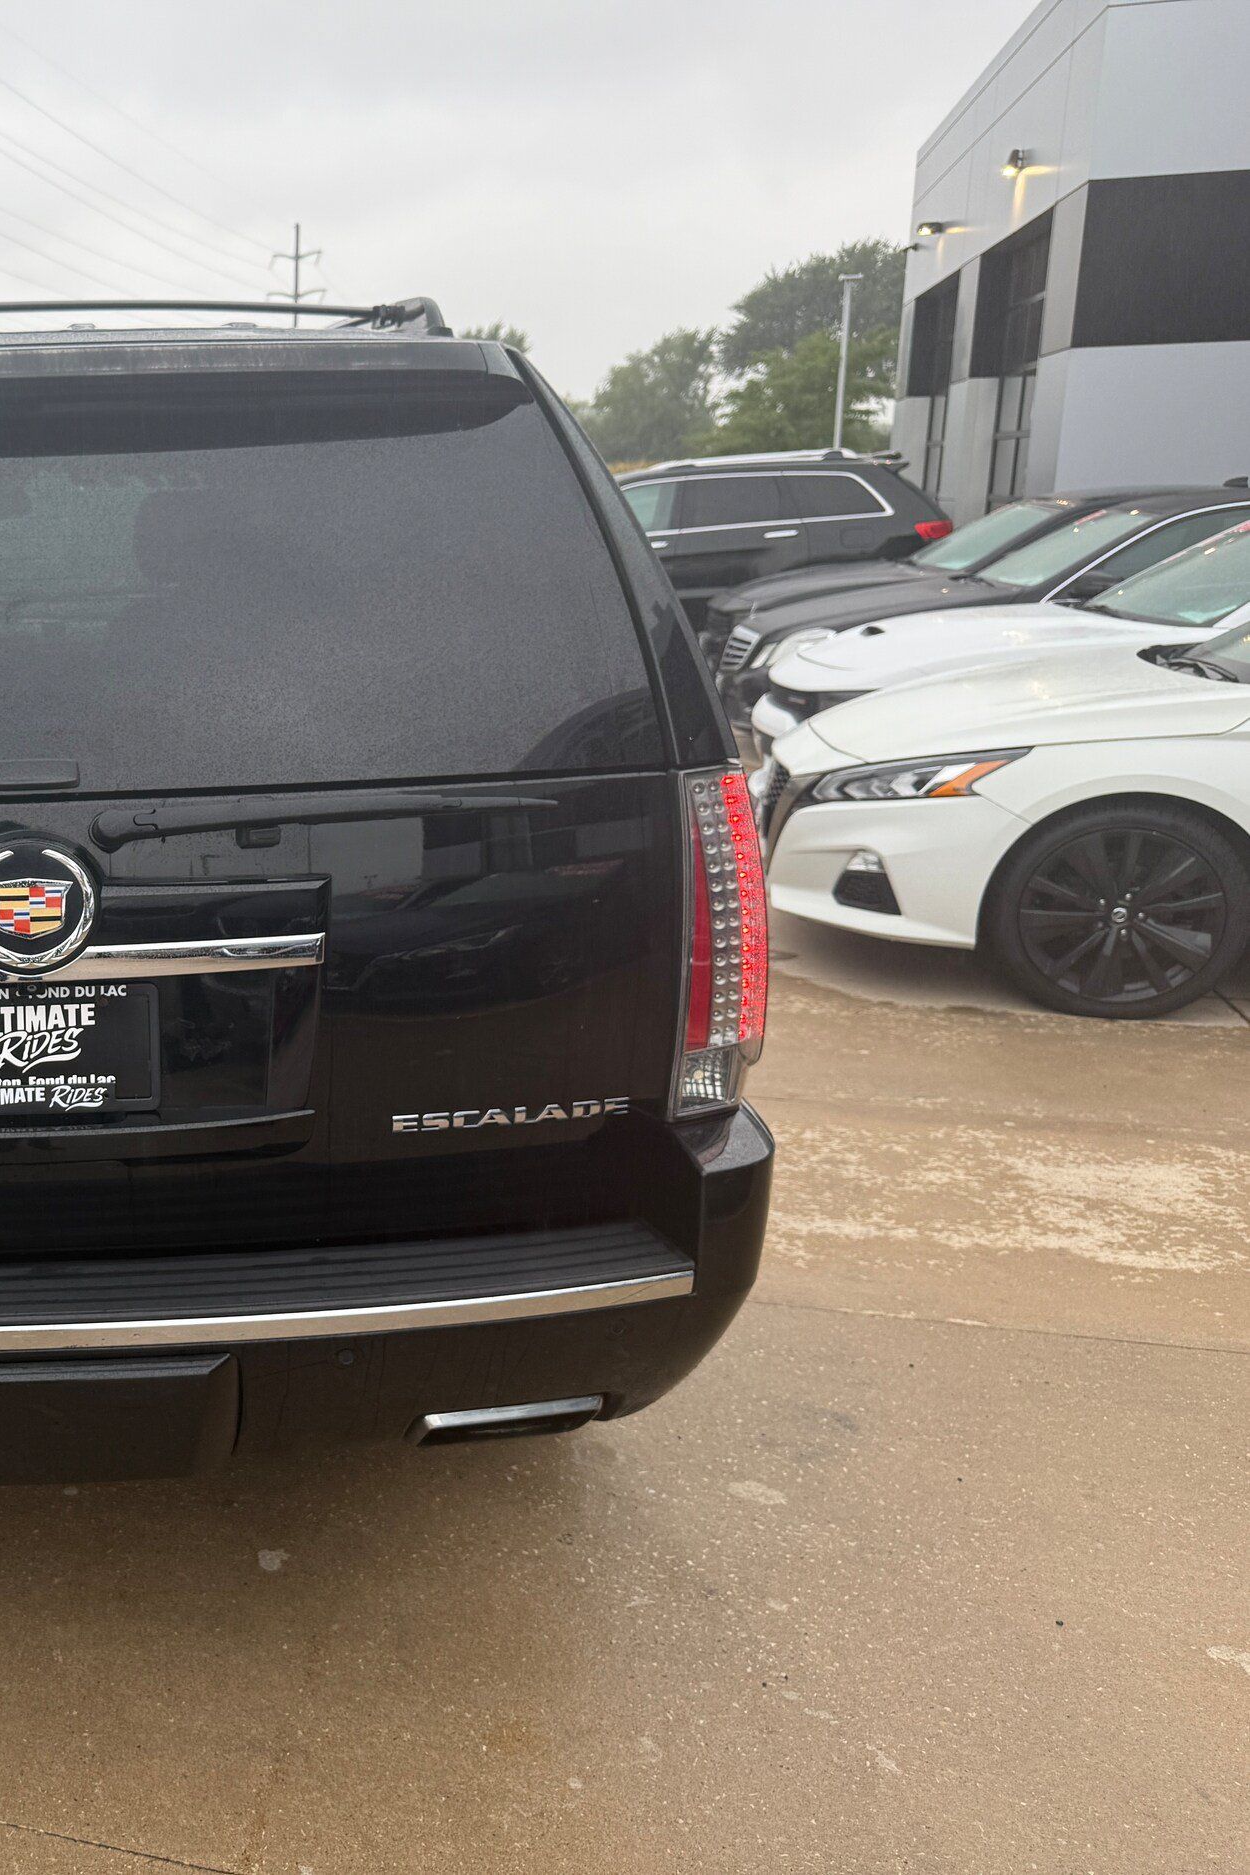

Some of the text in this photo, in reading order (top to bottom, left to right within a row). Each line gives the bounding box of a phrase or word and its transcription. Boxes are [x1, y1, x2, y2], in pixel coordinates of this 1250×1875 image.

[28, 985, 70, 999] OND
[75, 985, 96, 998] DU
[100, 984, 127, 997] LAC
[391, 1096, 630, 1133] ESCALADE
